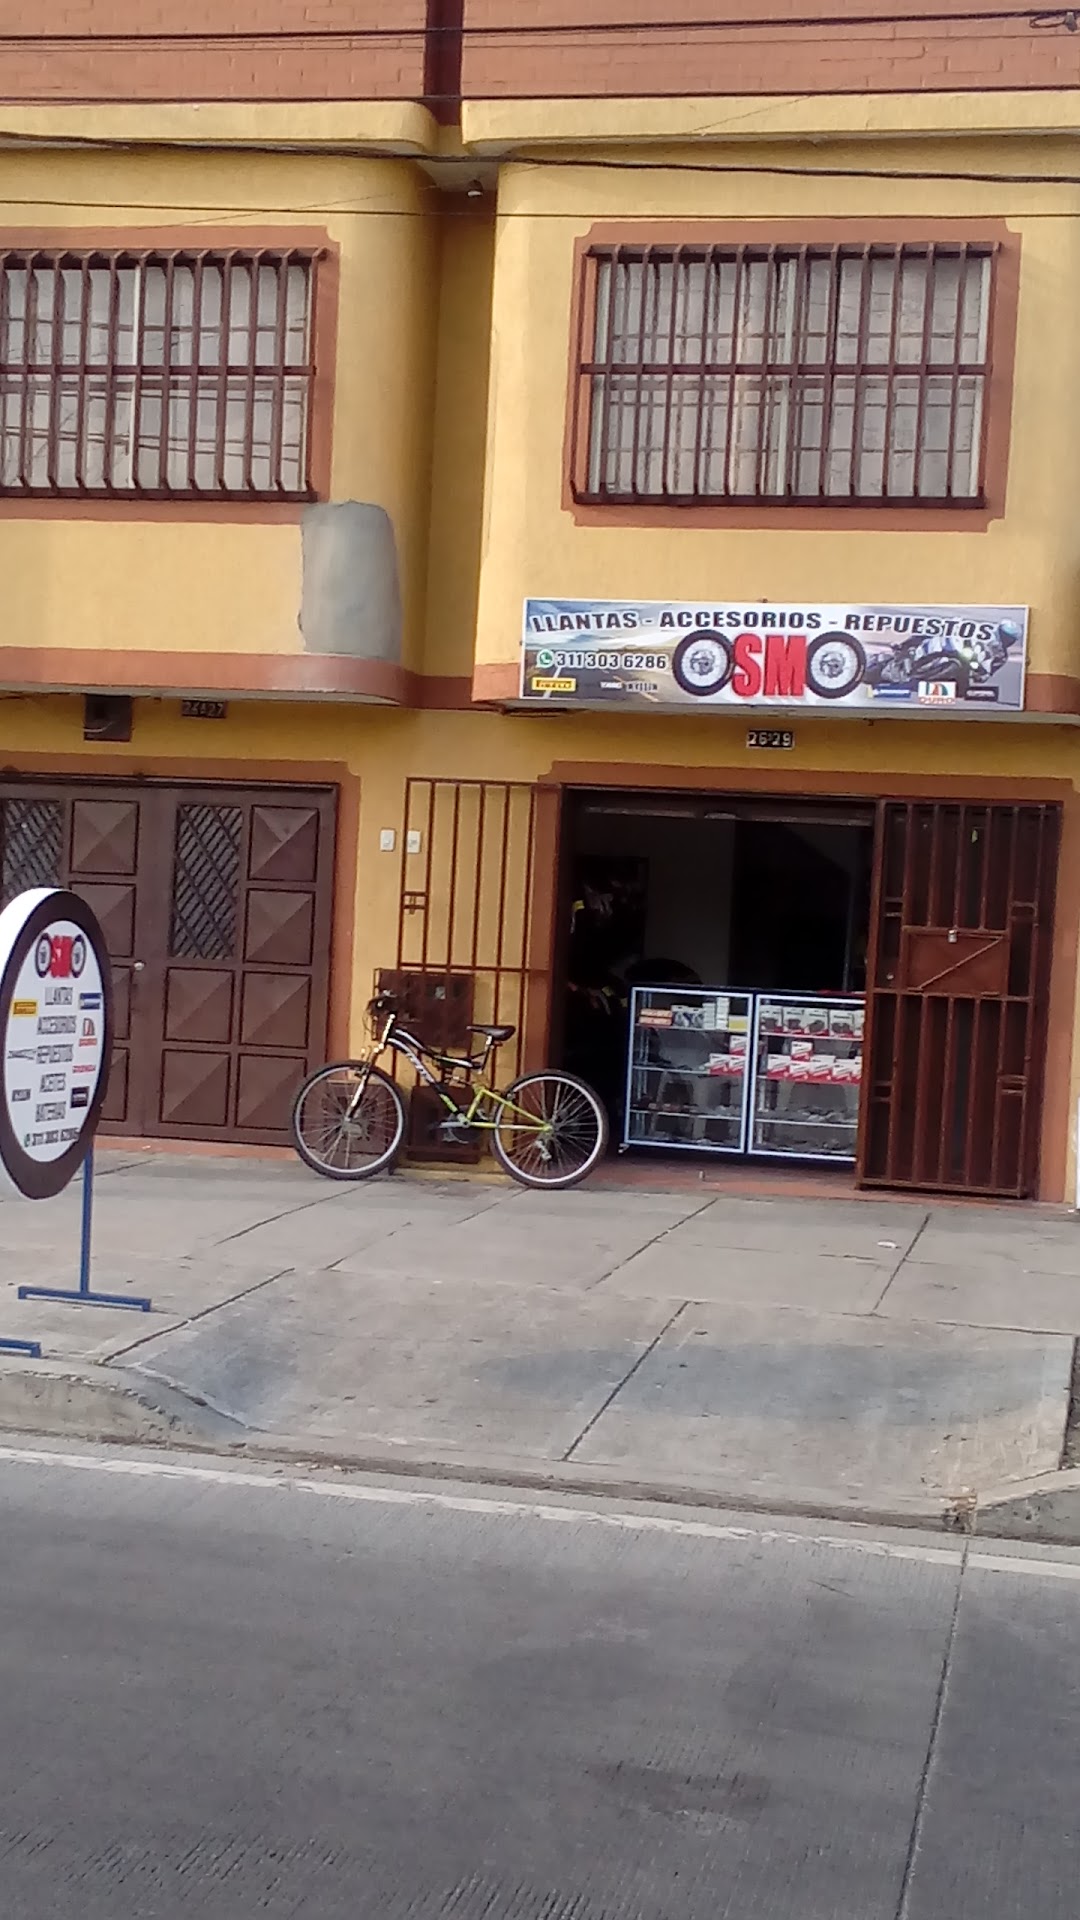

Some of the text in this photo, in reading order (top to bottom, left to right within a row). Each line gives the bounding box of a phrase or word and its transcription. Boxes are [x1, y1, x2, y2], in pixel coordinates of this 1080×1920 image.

[532, 612, 638, 633] LLANTAS
[660, 611, 822, 629] ACCESORIOS
[844, 614, 994, 641] REPUESTOS
[557, 652, 667, 669] 311 303 6286
[731, 633, 808, 698] SM
